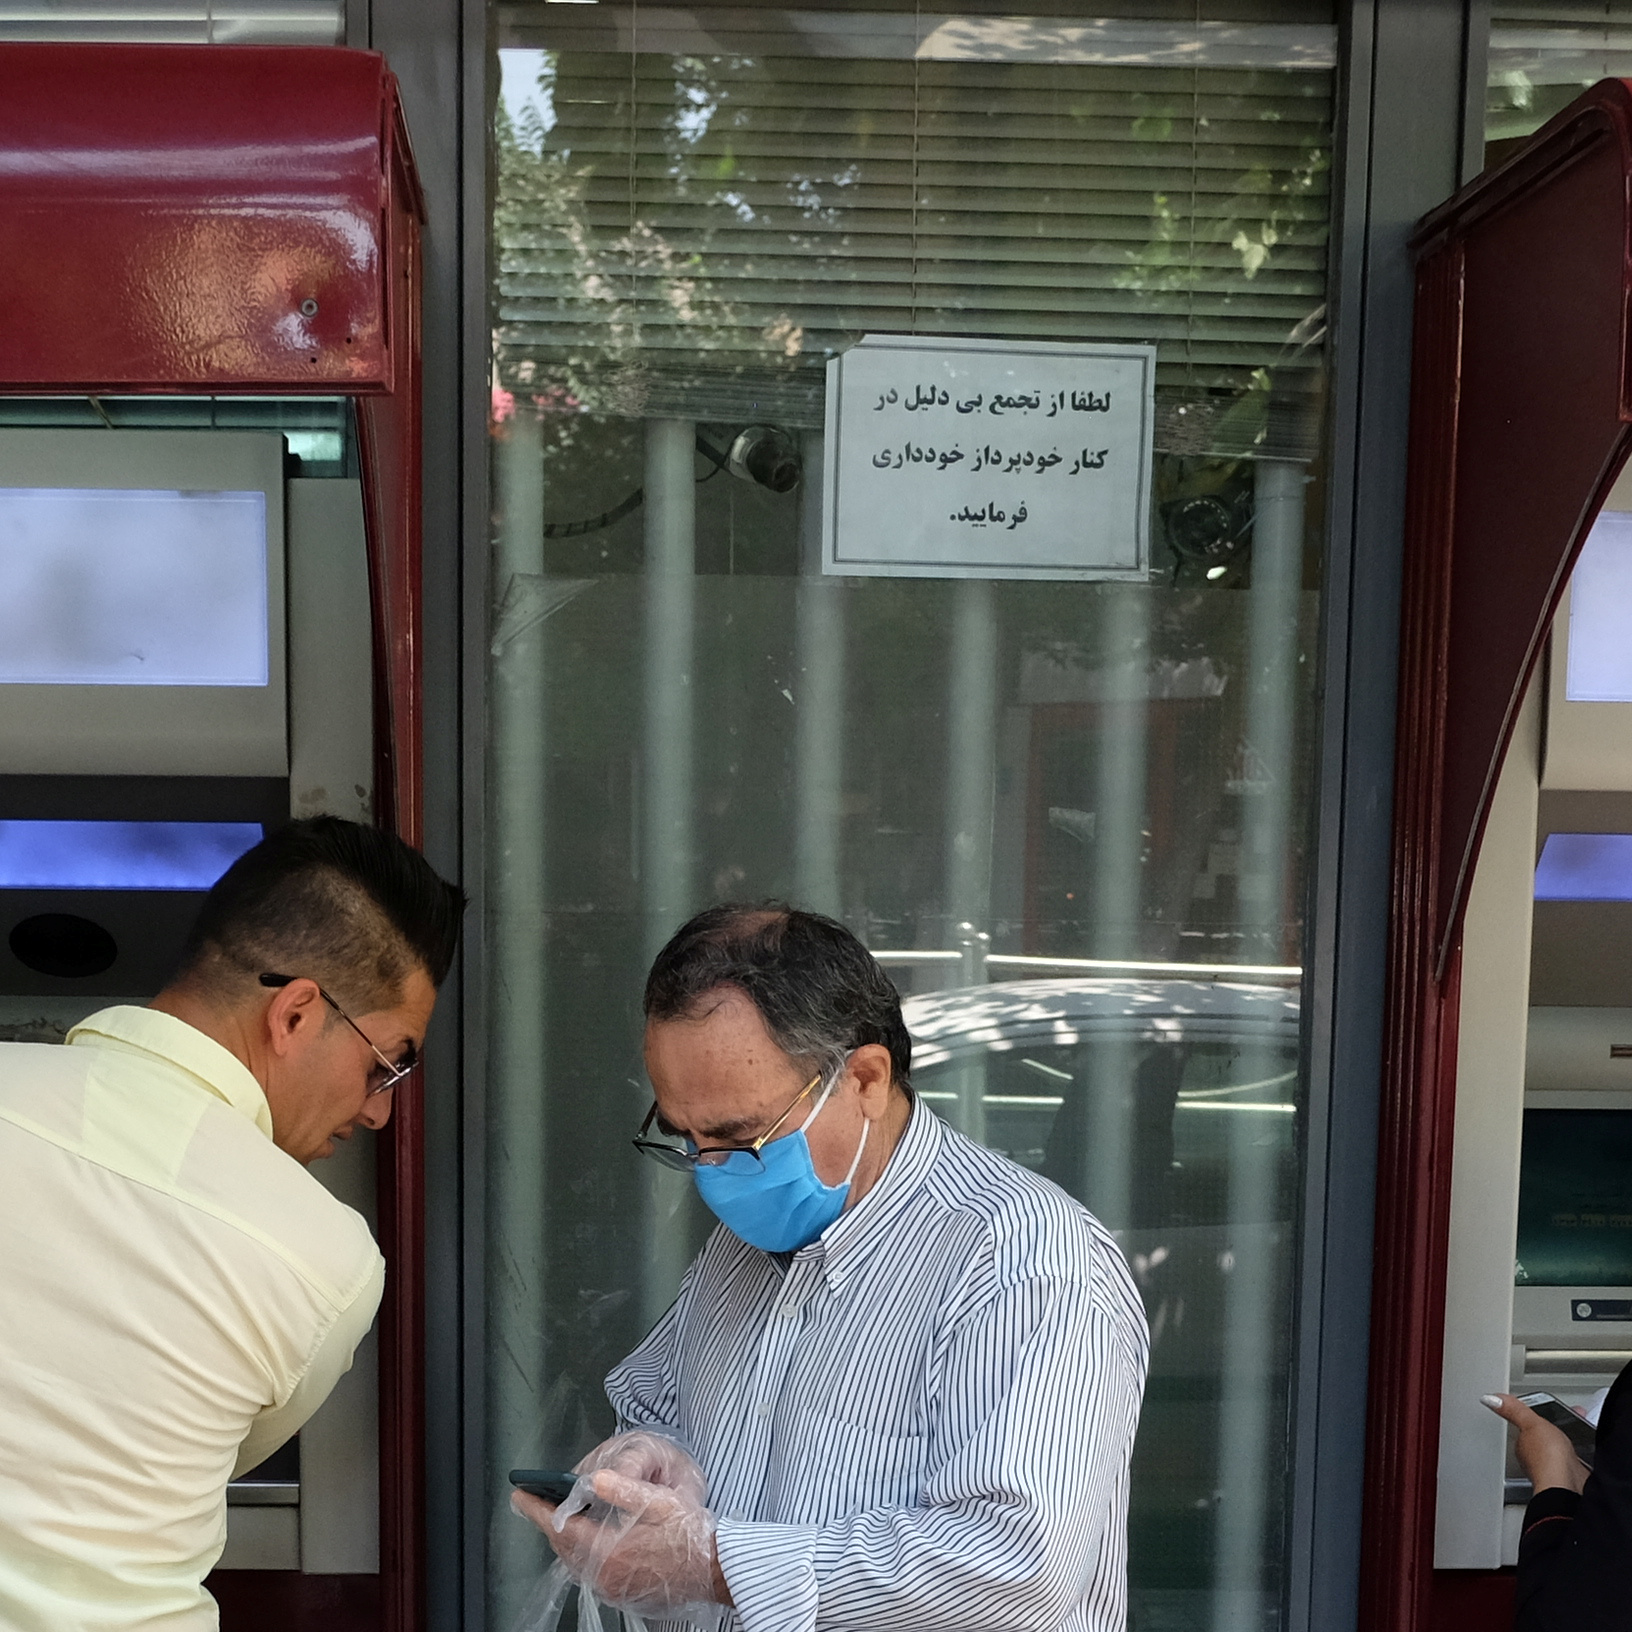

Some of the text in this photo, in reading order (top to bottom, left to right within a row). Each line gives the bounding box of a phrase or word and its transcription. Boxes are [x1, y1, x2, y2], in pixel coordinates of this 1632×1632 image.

[873, 384, 1111, 418] لطفا از تجمع بی دلیل در
[872, 441, 1109, 476] کنار خودپرداز خودداری
[949, 500, 1028, 531] فرمایید.
